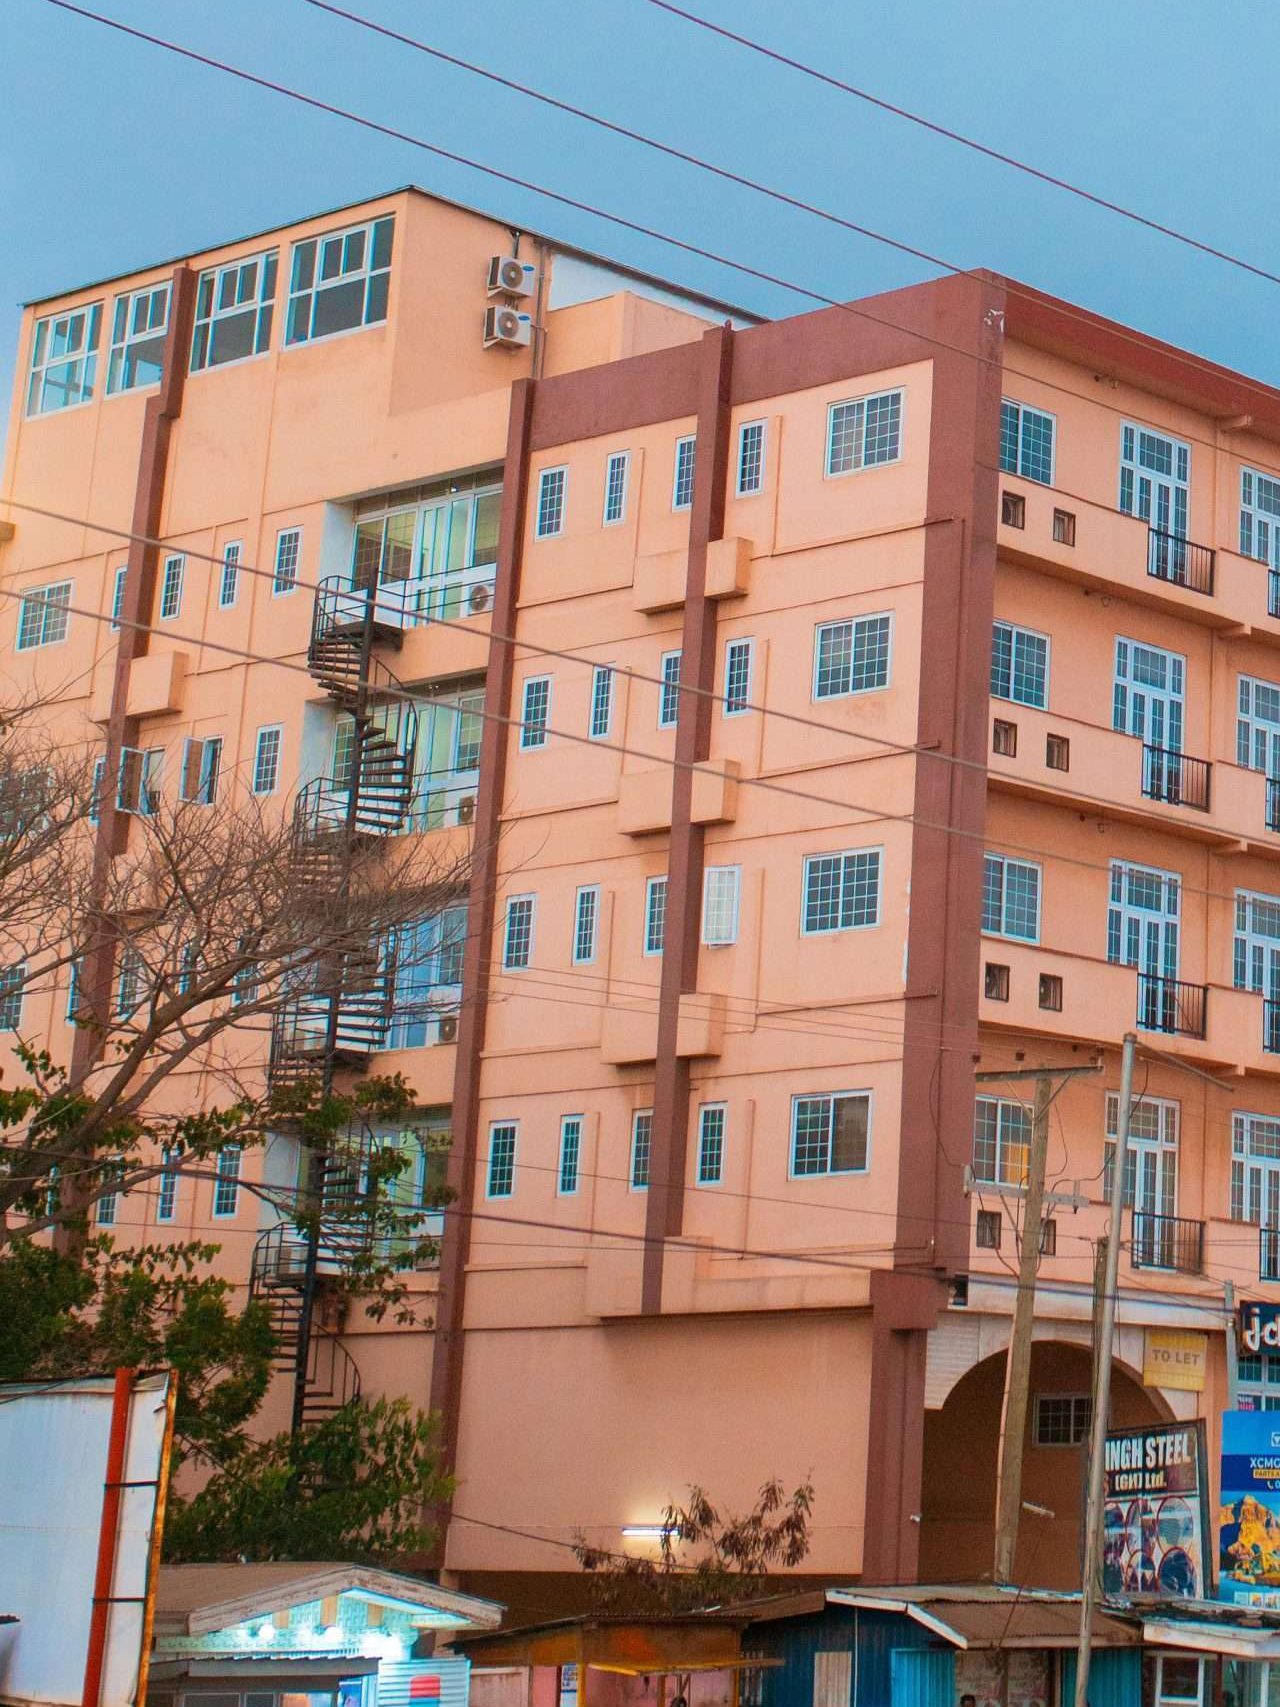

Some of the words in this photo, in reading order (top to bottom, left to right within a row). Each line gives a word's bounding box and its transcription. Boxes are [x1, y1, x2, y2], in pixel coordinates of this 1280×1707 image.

[1152, 1349, 1170, 1363] TO
[1175, 1351, 1200, 1367] LET
[1105, 1436, 1143, 1472] INGH
[1145, 1433, 1192, 1469] STEEL
[1249, 1457, 1280, 1469] XCMG
[1145, 1470, 1167, 1490] Ltd.
